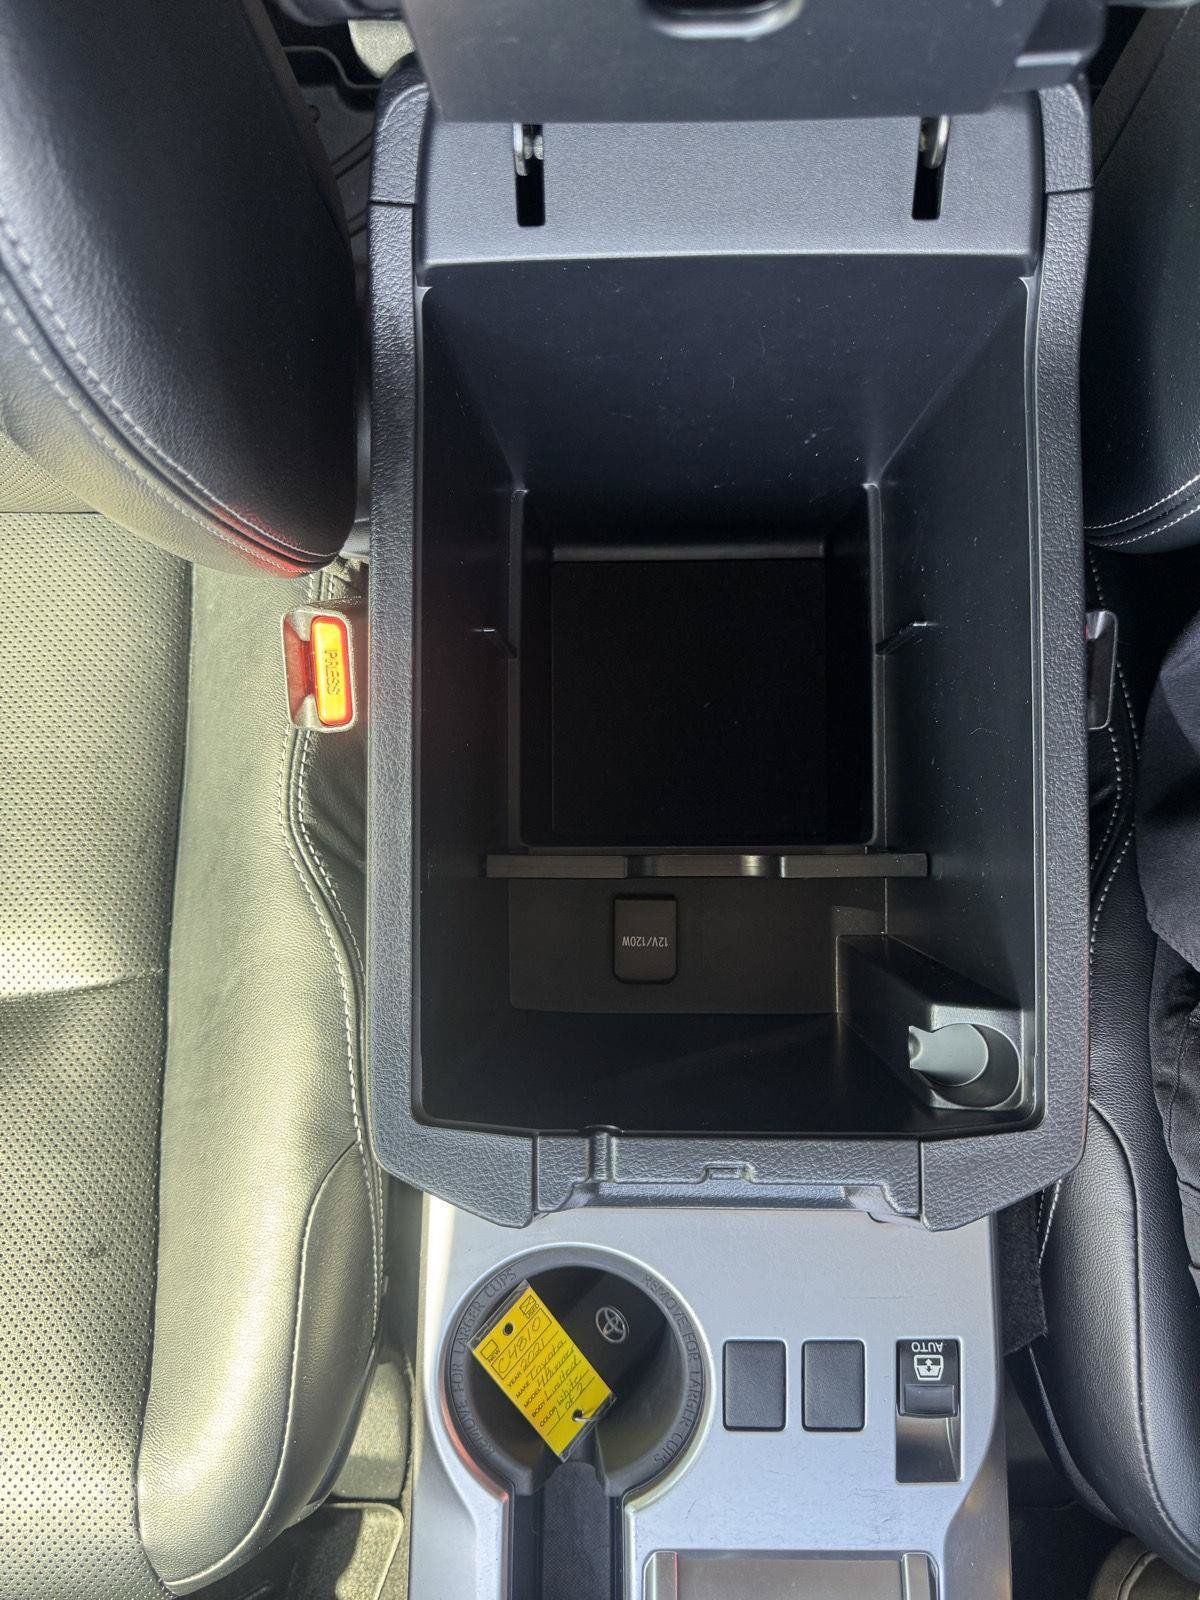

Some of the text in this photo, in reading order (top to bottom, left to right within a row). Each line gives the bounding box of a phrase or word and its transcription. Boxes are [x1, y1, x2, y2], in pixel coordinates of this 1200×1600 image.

[325, 651, 340, 695] PRESS
[622, 936, 668, 947] 12V/120W
[525, 1303, 540, 1319] USED
[452, 1363, 465, 1392] FOR
[485, 1271, 518, 1297] CUPS
[498, 1315, 541, 1373] C4810
[912, 1341, 943, 1353] AUTO
[487, 1347, 501, 1363] NEW
[508, 1337, 544, 1387] YEAR 2021
[645, 1273, 701, 1465] REMOVE FOR LARGER CUPS
[516, 1382, 530, 1398] MAKE
[523, 1387, 541, 1407] MODEL
[575, 1382, 585, 1394] 2
[531, 1401, 546, 1418] BODY
[539, 1405, 557, 1427] COLOR
